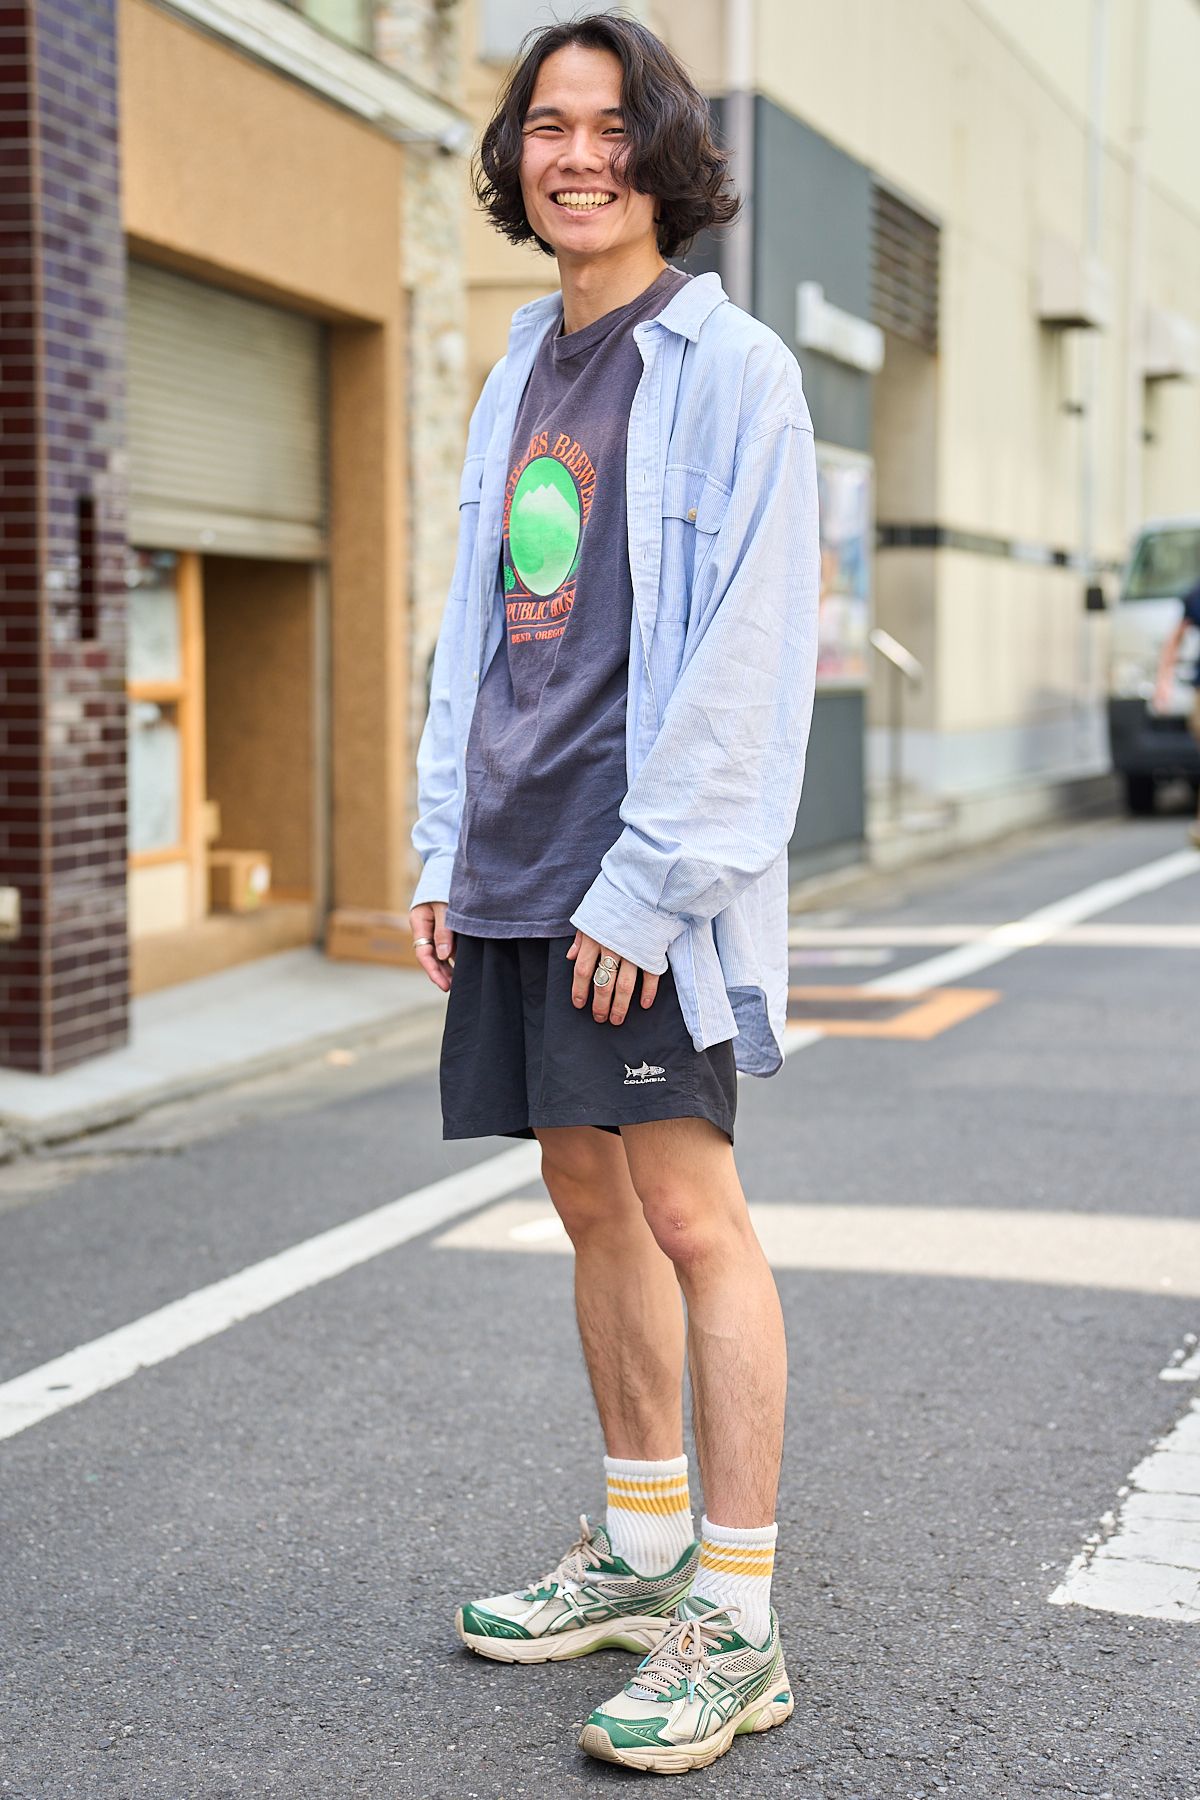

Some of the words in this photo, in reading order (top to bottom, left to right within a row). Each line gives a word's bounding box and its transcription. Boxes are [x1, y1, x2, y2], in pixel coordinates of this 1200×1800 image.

[506, 601, 550, 622] PUBLIC
[550, 588, 577, 617] HOUS
[535, 626, 566, 640] OREGO
[623, 1077, 667, 1085] COLUMBIA
